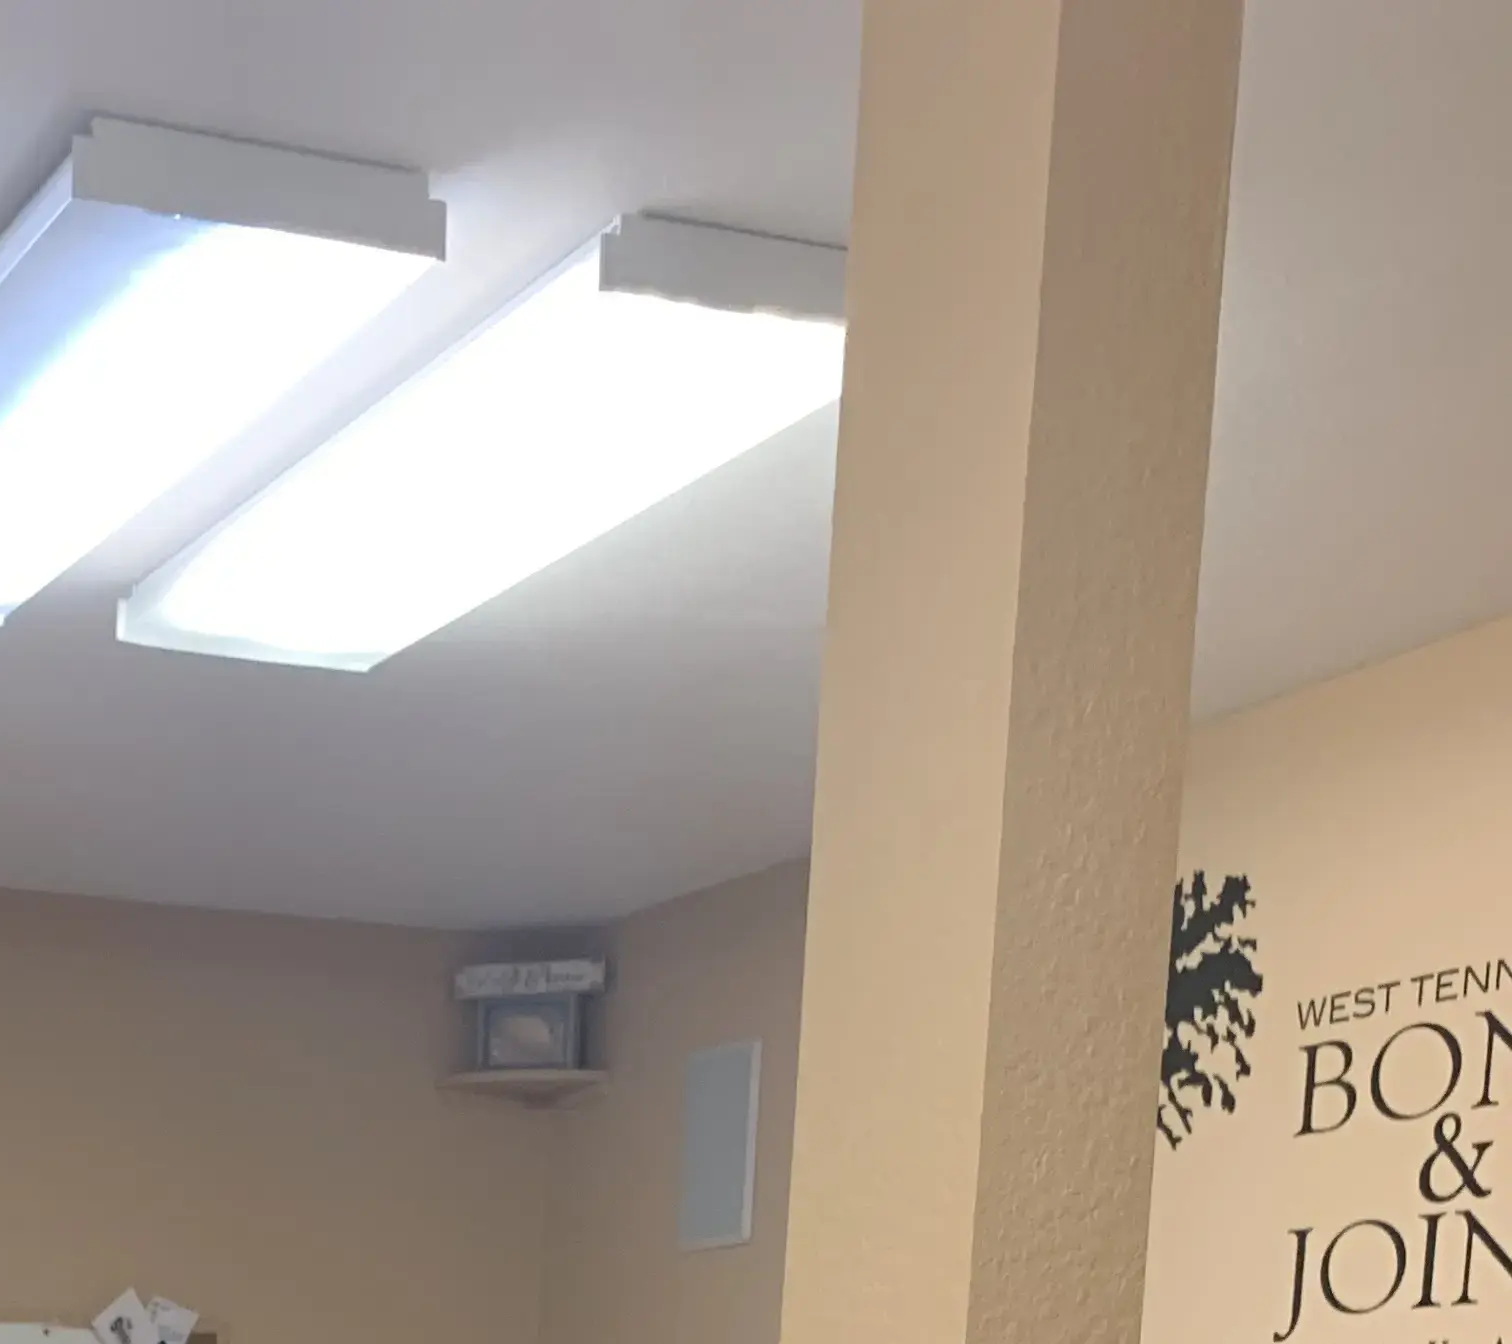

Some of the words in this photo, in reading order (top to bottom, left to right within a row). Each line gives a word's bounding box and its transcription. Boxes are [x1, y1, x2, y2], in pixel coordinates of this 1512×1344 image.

[1296, 980, 1401, 1031] WEST
[1410, 958, 1512, 1008] TENN
[1293, 1009, 1512, 1138] BON
[1418, 1111, 1495, 1204] &
[1273, 1208, 1512, 1343] JOIN
